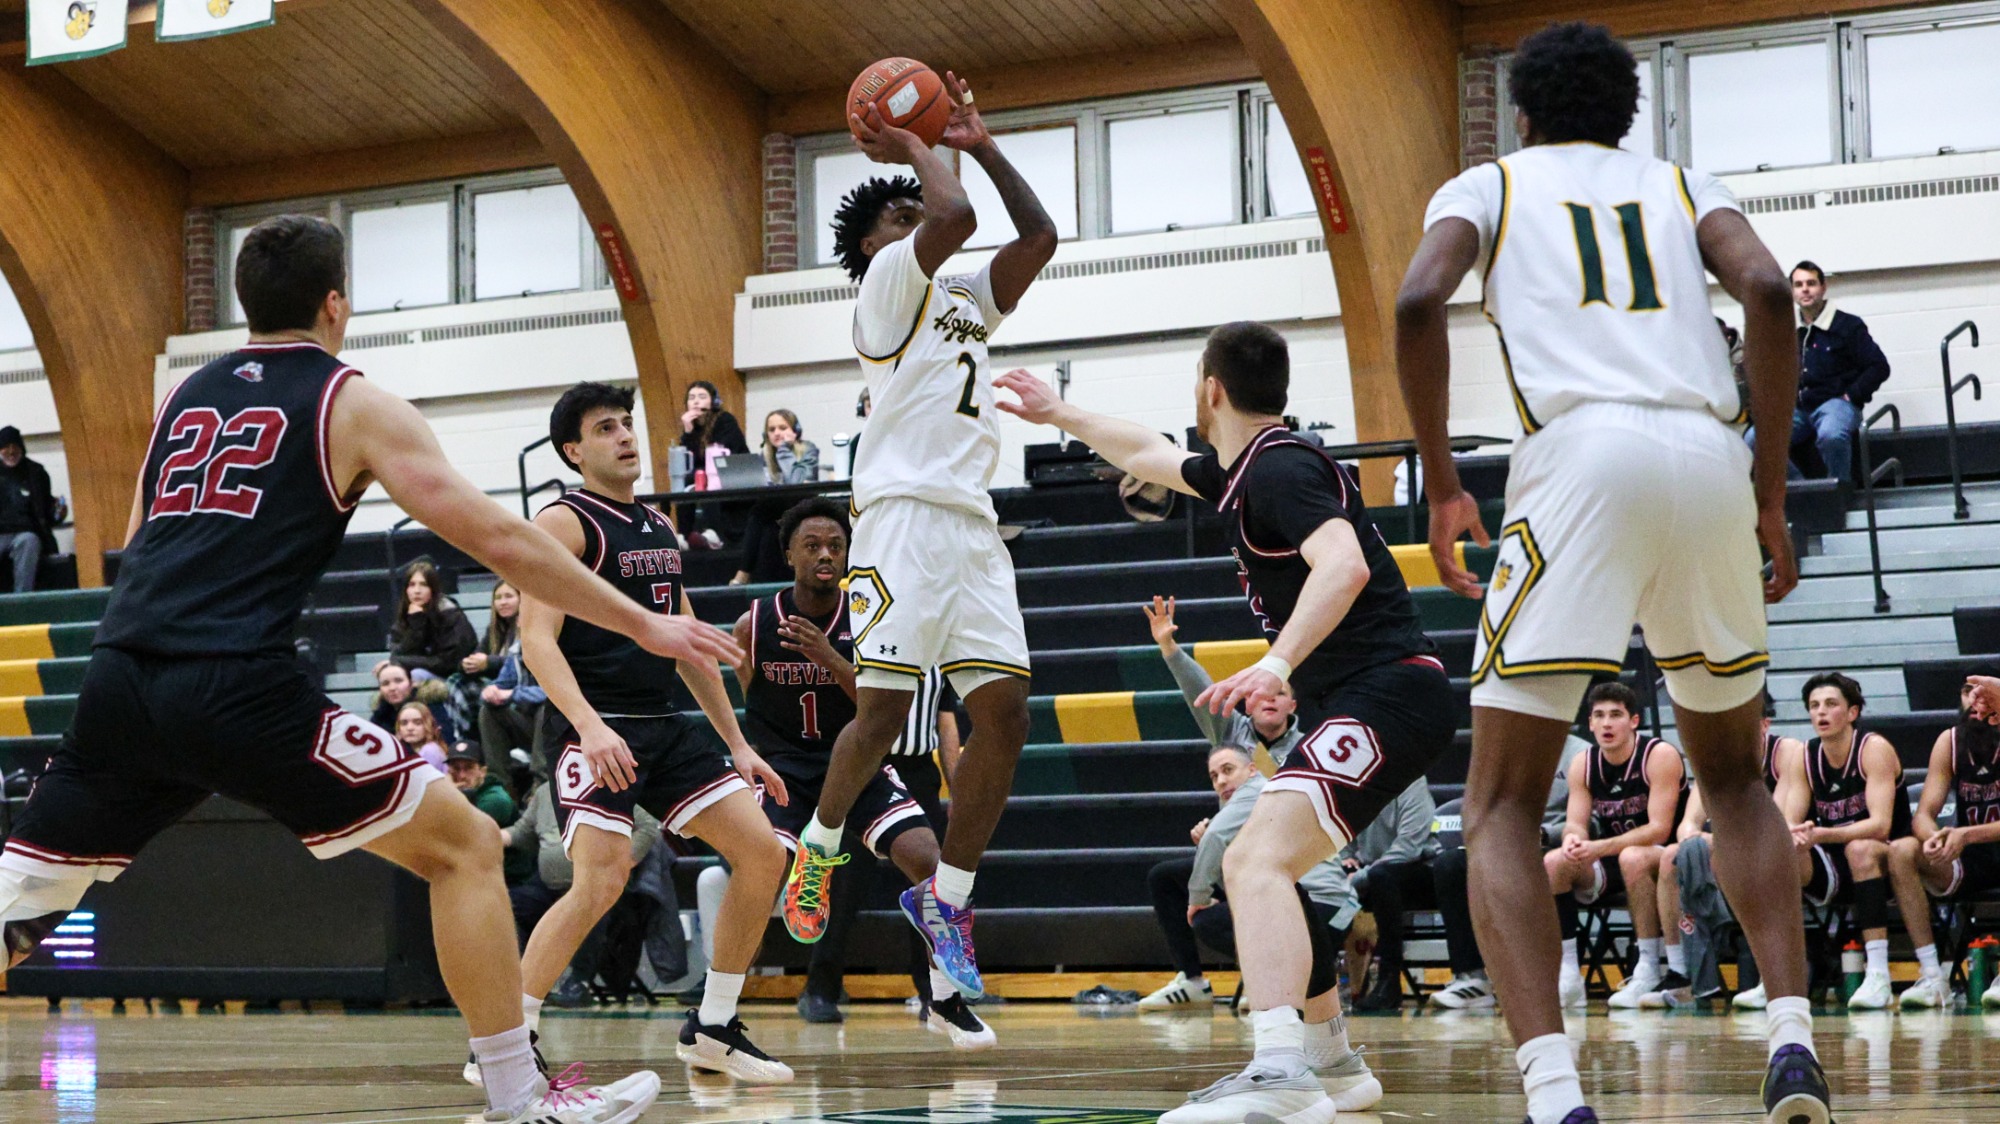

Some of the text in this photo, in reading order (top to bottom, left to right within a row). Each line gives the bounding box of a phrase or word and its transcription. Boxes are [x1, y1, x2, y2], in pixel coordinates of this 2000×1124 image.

[1310, 156, 1342, 223] NO SMOKING
[1557, 199, 1668, 313] 11
[955, 350, 981, 420] 2
[148, 406, 289, 522] 22
[651, 582, 673, 616] 7
[761, 661, 840, 686] STEVE
[799, 691, 822, 740] 1
[345, 725, 383, 756] S
[1328, 735, 1359, 763] S
[566, 761, 581, 789] S
